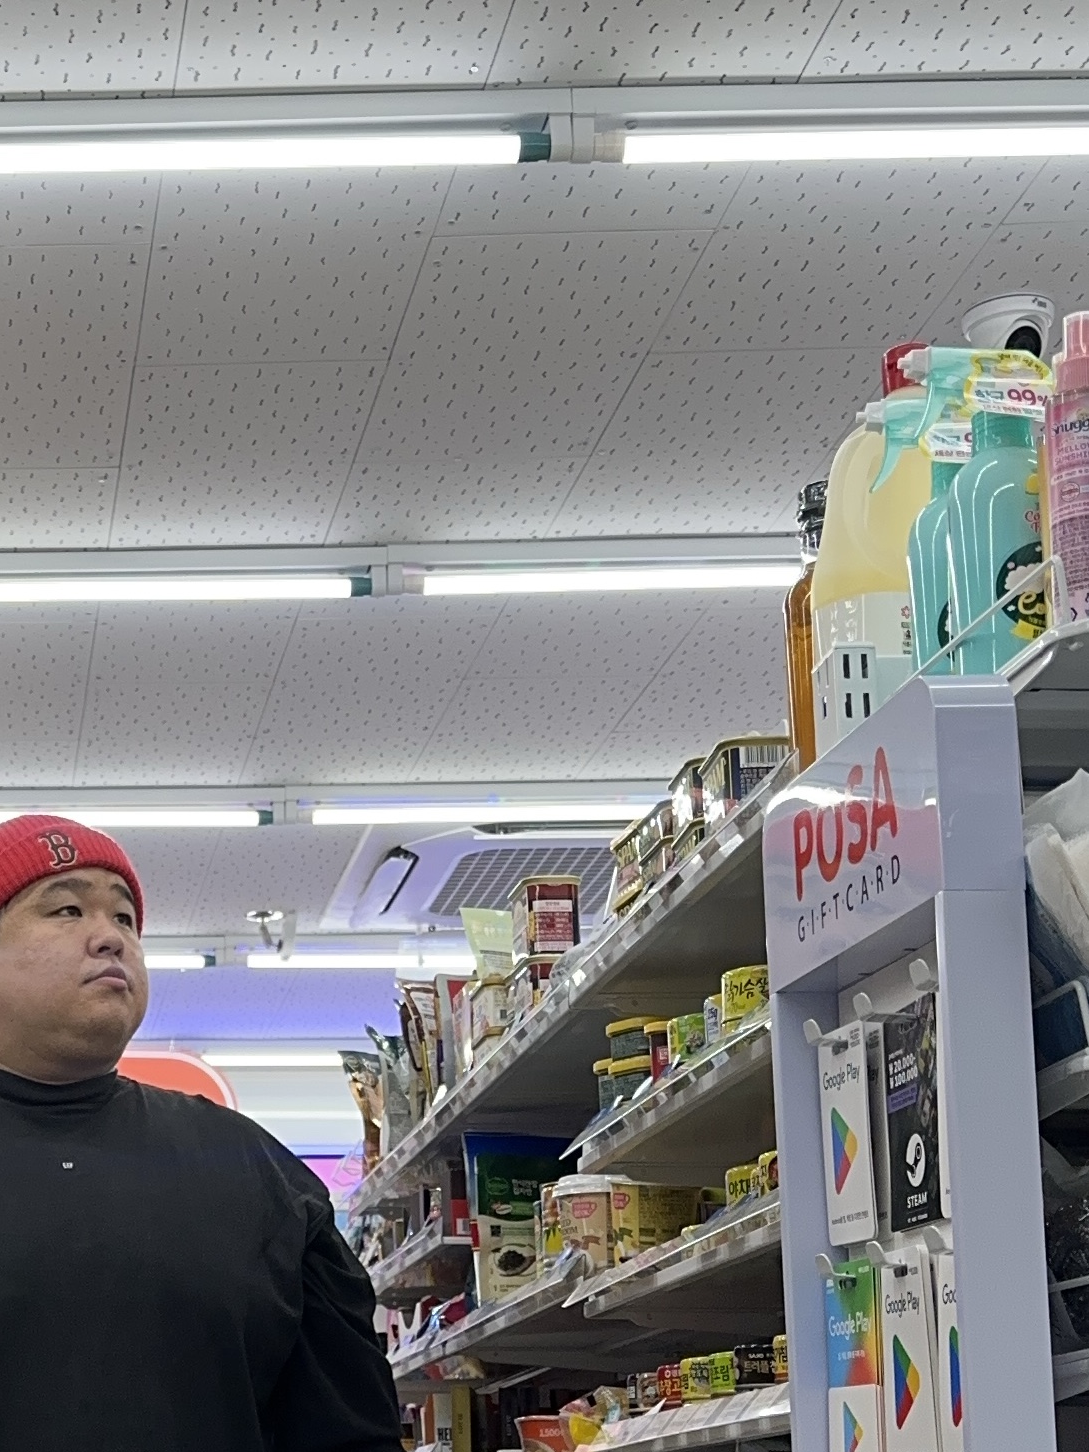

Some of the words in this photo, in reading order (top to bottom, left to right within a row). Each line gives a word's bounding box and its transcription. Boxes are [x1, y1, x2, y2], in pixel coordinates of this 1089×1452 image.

[37, 832, 78, 869] B
[822, 1066, 847, 1092] Google
[846, 1062, 861, 1085] Play
[906, 1191, 928, 1210] STEAM
[885, 1292, 907, 1318] Google
[907, 1291, 921, 1315] Play
[828, 1315, 856, 1341] Google
